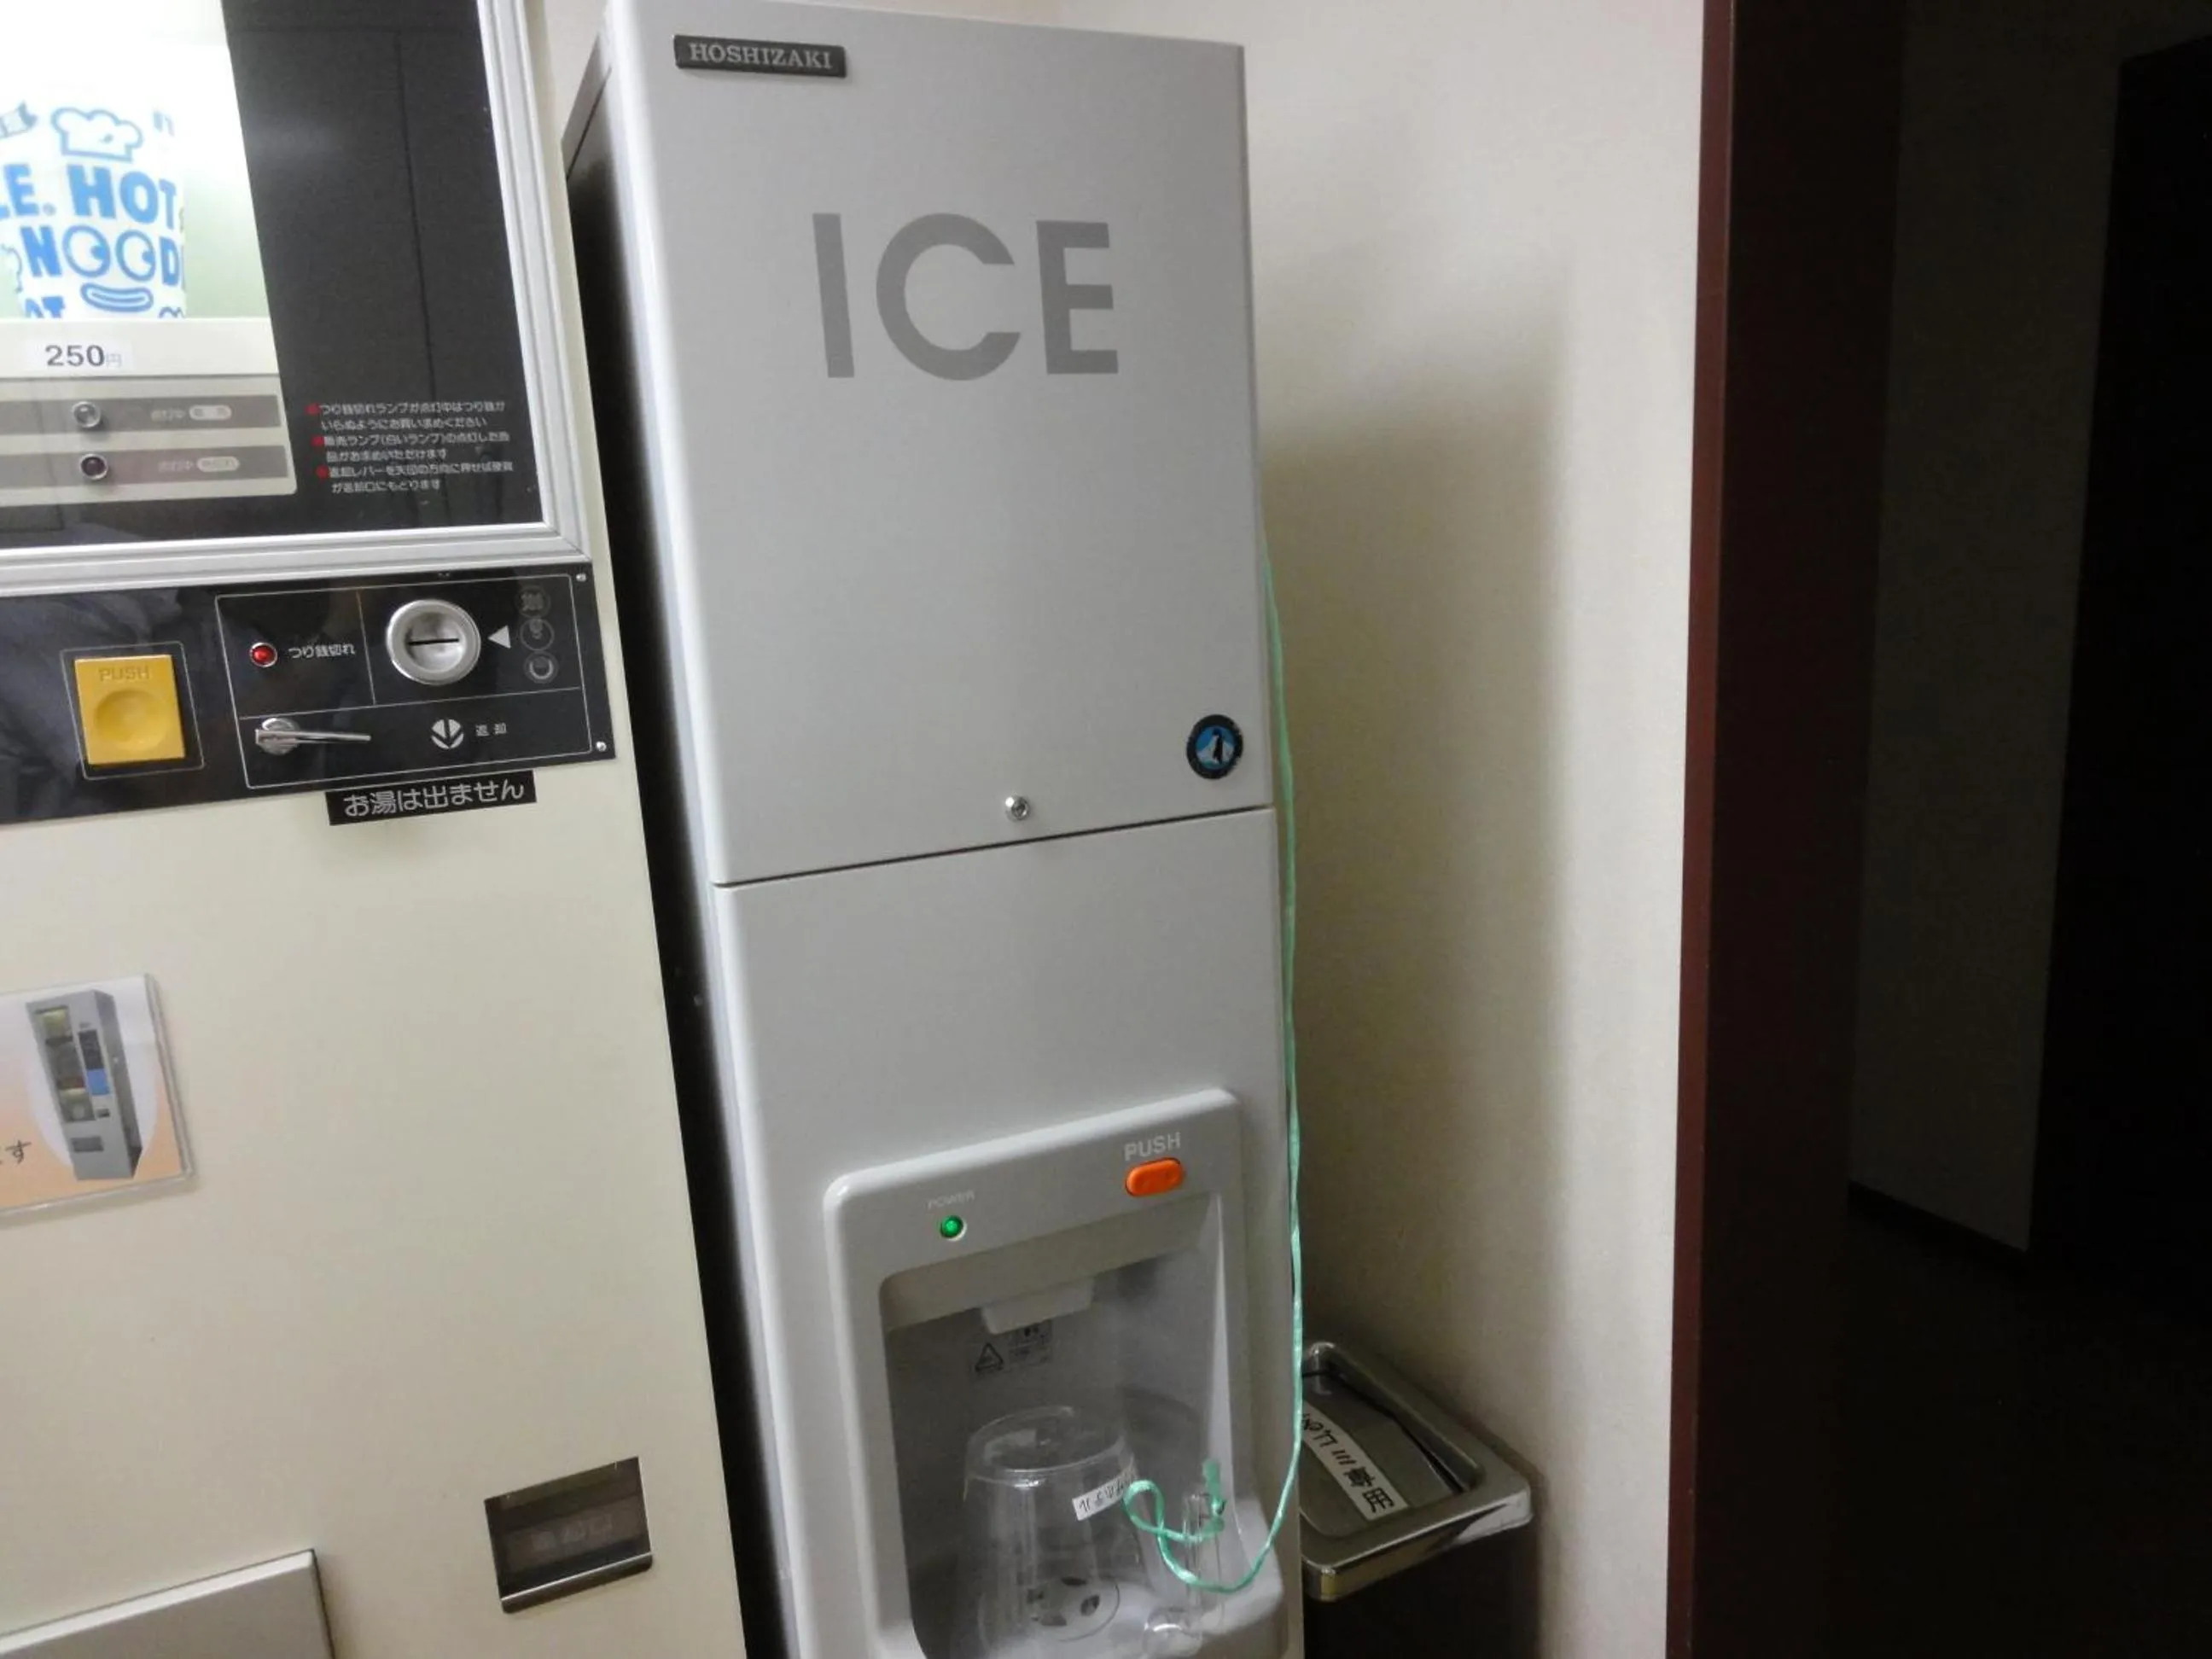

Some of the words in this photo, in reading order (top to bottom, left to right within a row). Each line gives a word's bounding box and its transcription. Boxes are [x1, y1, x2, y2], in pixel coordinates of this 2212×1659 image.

[690, 42, 834, 70] HOSHIZAKI
[67, 164, 177, 229] HOT
[812, 212, 1120, 381] ICE
[98, 666, 150, 682] PUSH
[343, 779, 525, 817] お湯は出ません
[1124, 1132, 1182, 1161] PUSH
